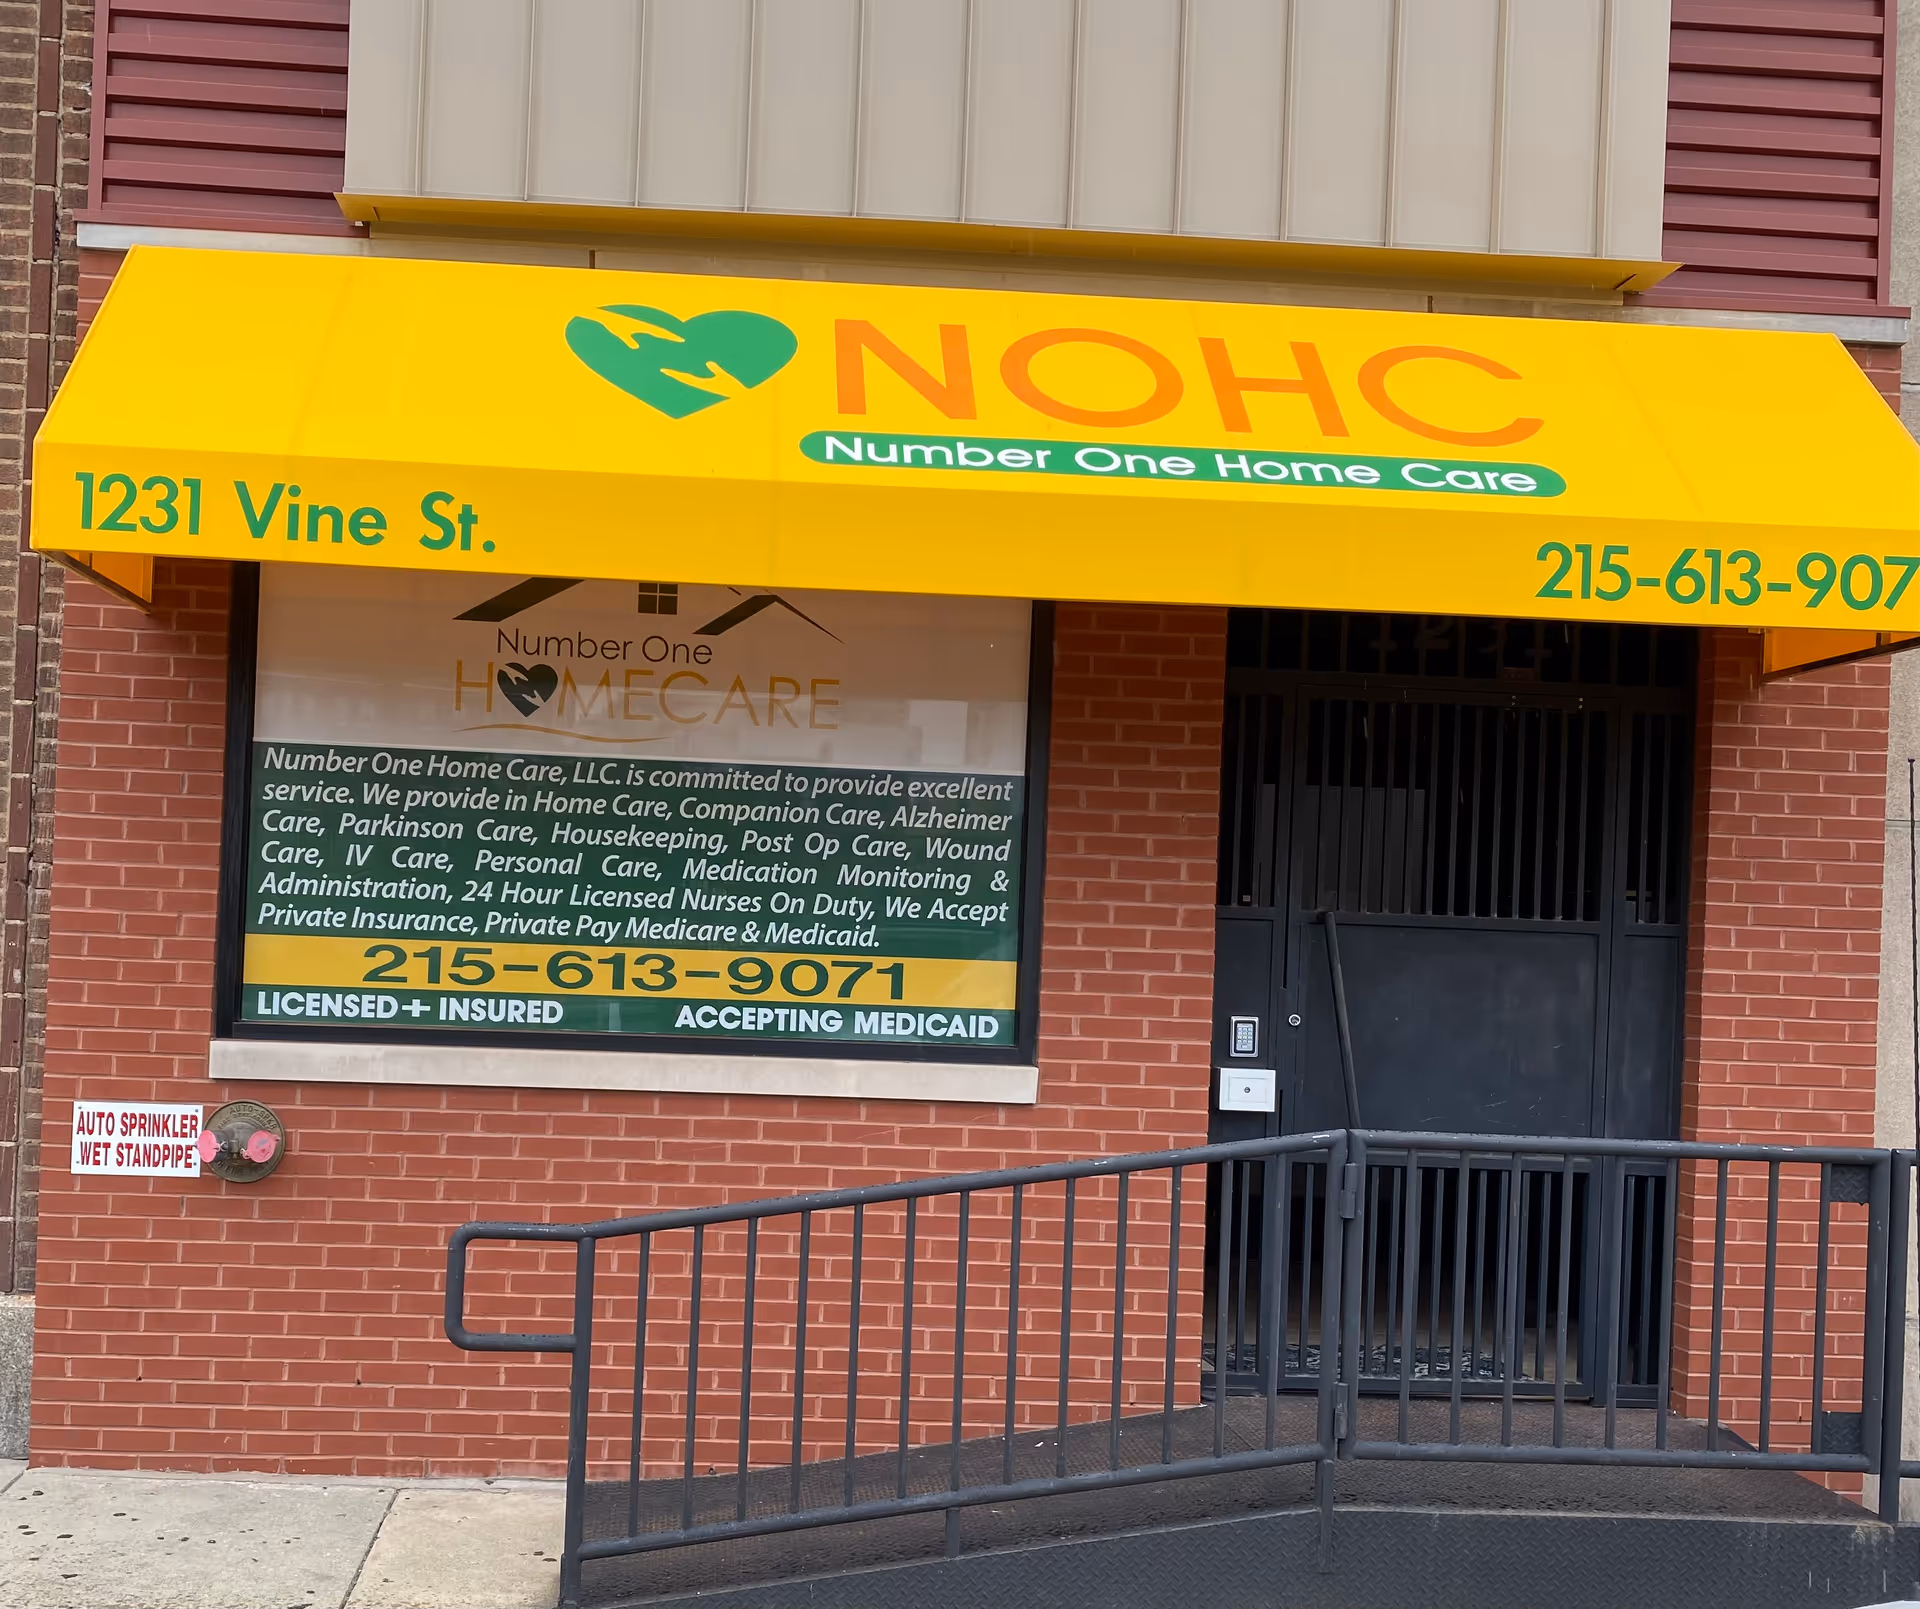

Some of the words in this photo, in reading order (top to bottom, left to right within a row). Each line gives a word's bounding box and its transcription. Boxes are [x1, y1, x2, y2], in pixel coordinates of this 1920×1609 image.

[835, 318, 1544, 448] NOHC
[826, 436, 1051, 468] Number
[1075, 448, 1195, 475] One
[1215, 454, 1380, 483] Home
[1402, 463, 1537, 491] Care
[75, 472, 201, 535] 1231
[234, 480, 387, 546] Vine
[419, 491, 496, 553] St.
[498, 628, 633, 660] Number
[642, 636, 712, 664] One
[454, 660, 841, 731] HMECARE
[264, 747, 368, 772] Number
[372, 753, 422, 775] One
[427, 755, 501, 779] Home
[507, 759, 567, 785] Care,
[573, 762, 620, 784] LLC.
[626, 764, 644, 785] is
[649, 768, 781, 791] committed
[785, 773, 808, 792] to
[811, 774, 903, 798] provide
[908, 777, 1013, 800] excellent
[262, 780, 354, 803] service.
[364, 783, 400, 805] We
[404, 787, 499, 811] provide
[505, 789, 527, 811] in
[533, 791, 606, 814] Home
[613, 794, 672, 820] Care,
[680, 797, 819, 826] Companion
[826, 803, 885, 829] Care,
[890, 806, 1012, 830] Alzheimer
[263, 810, 325, 836] Care,
[339, 813, 463, 839] Parkinson
[477, 819, 537, 845] Care,
[551, 822, 728, 855] Housekeeping,
[741, 830, 793, 853] Post
[805, 833, 839, 860] Op
[852, 835, 911, 860] Care,
[927, 837, 1011, 861] Wound
[262, 841, 324, 867] Care,
[346, 844, 373, 866] IV
[392, 846, 453, 873] Care,
[475, 850, 583, 874] Personal
[602, 855, 662, 881] Care,
[683, 858, 817, 884] Medication
[837, 864, 971, 895] Monitoring
[990, 870, 1009, 891] &
[258, 872, 453, 904] Administration,
[461, 881, 493, 902] 24
[501, 882, 563, 904] Hour
[570, 884, 675, 909] Licensed
[681, 889, 762, 912] Nurses
[770, 892, 804, 913] On
[813, 894, 875, 922] Duty,
[886, 896, 921, 918] We
[927, 898, 1009, 926] Accept
[258, 903, 346, 927] Private
[351, 907, 478, 935] Insurance,
[485, 912, 571, 936] Private
[576, 915, 621, 943] Pay
[625, 917, 737, 941] Medicare
[741, 921, 760, 942] &
[765, 922, 879, 947] Medicaid.
[361, 943, 904, 1000] 215-613-9071
[440, 998, 563, 1023] INSURED
[675, 1005, 843, 1032] ACCEPTING
[854, 1011, 998, 1041] MEDICAID
[77, 1112, 115, 1136] AUTO
[120, 1112, 198, 1138] SPRINKLER
[80, 1142, 111, 1165] WET
[116, 1143, 193, 1168] STANDPIPE
